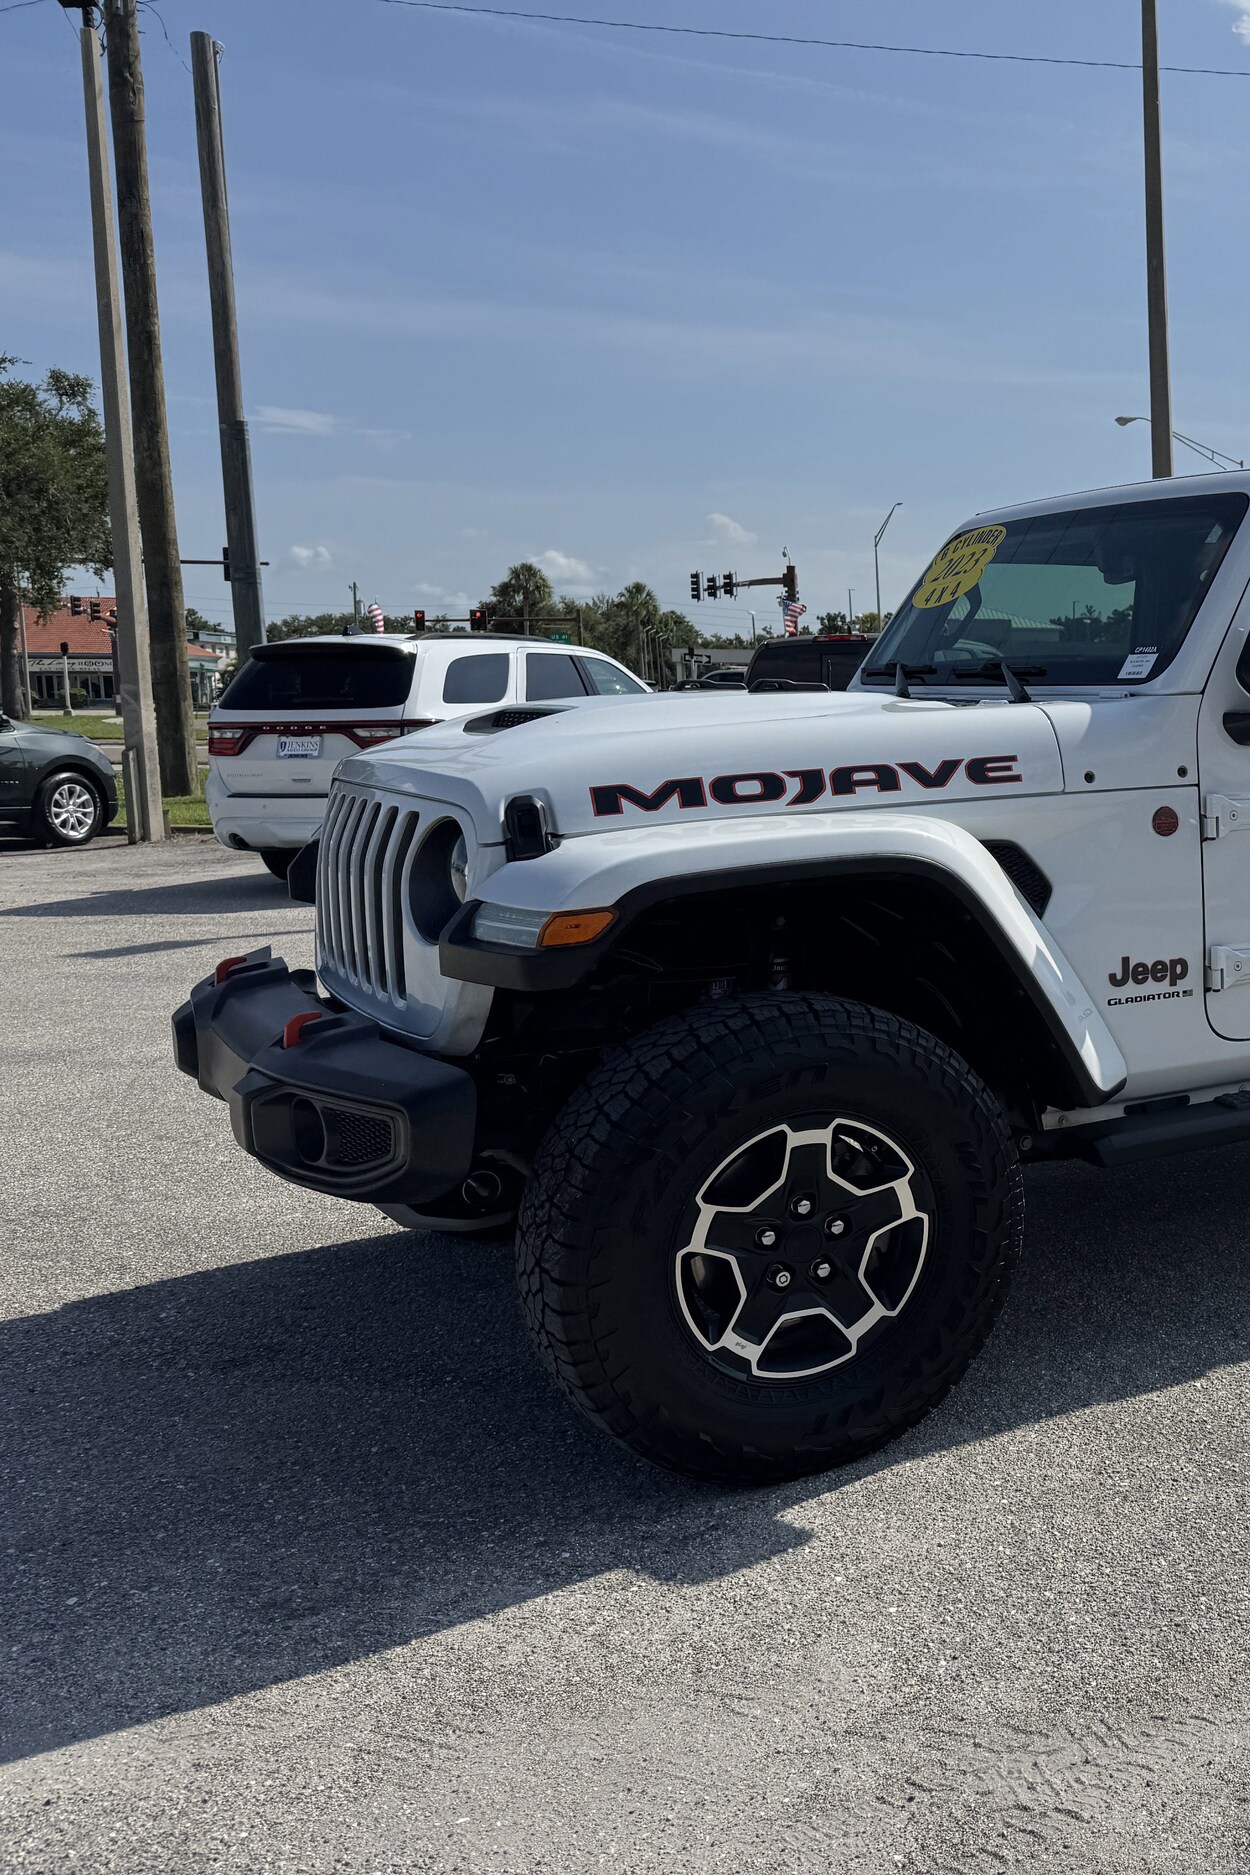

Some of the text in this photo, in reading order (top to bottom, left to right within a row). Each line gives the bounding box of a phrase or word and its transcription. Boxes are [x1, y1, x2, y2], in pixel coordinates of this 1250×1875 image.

[952, 529, 1003, 553] CYLINDER
[930, 548, 988, 583] 2023
[288, 741, 319, 749] JENKINS
[588, 754, 1024, 817] MOJAVE
[1108, 956, 1189, 988] Jeep
[1107, 991, 1181, 1007] GLADIATOR
